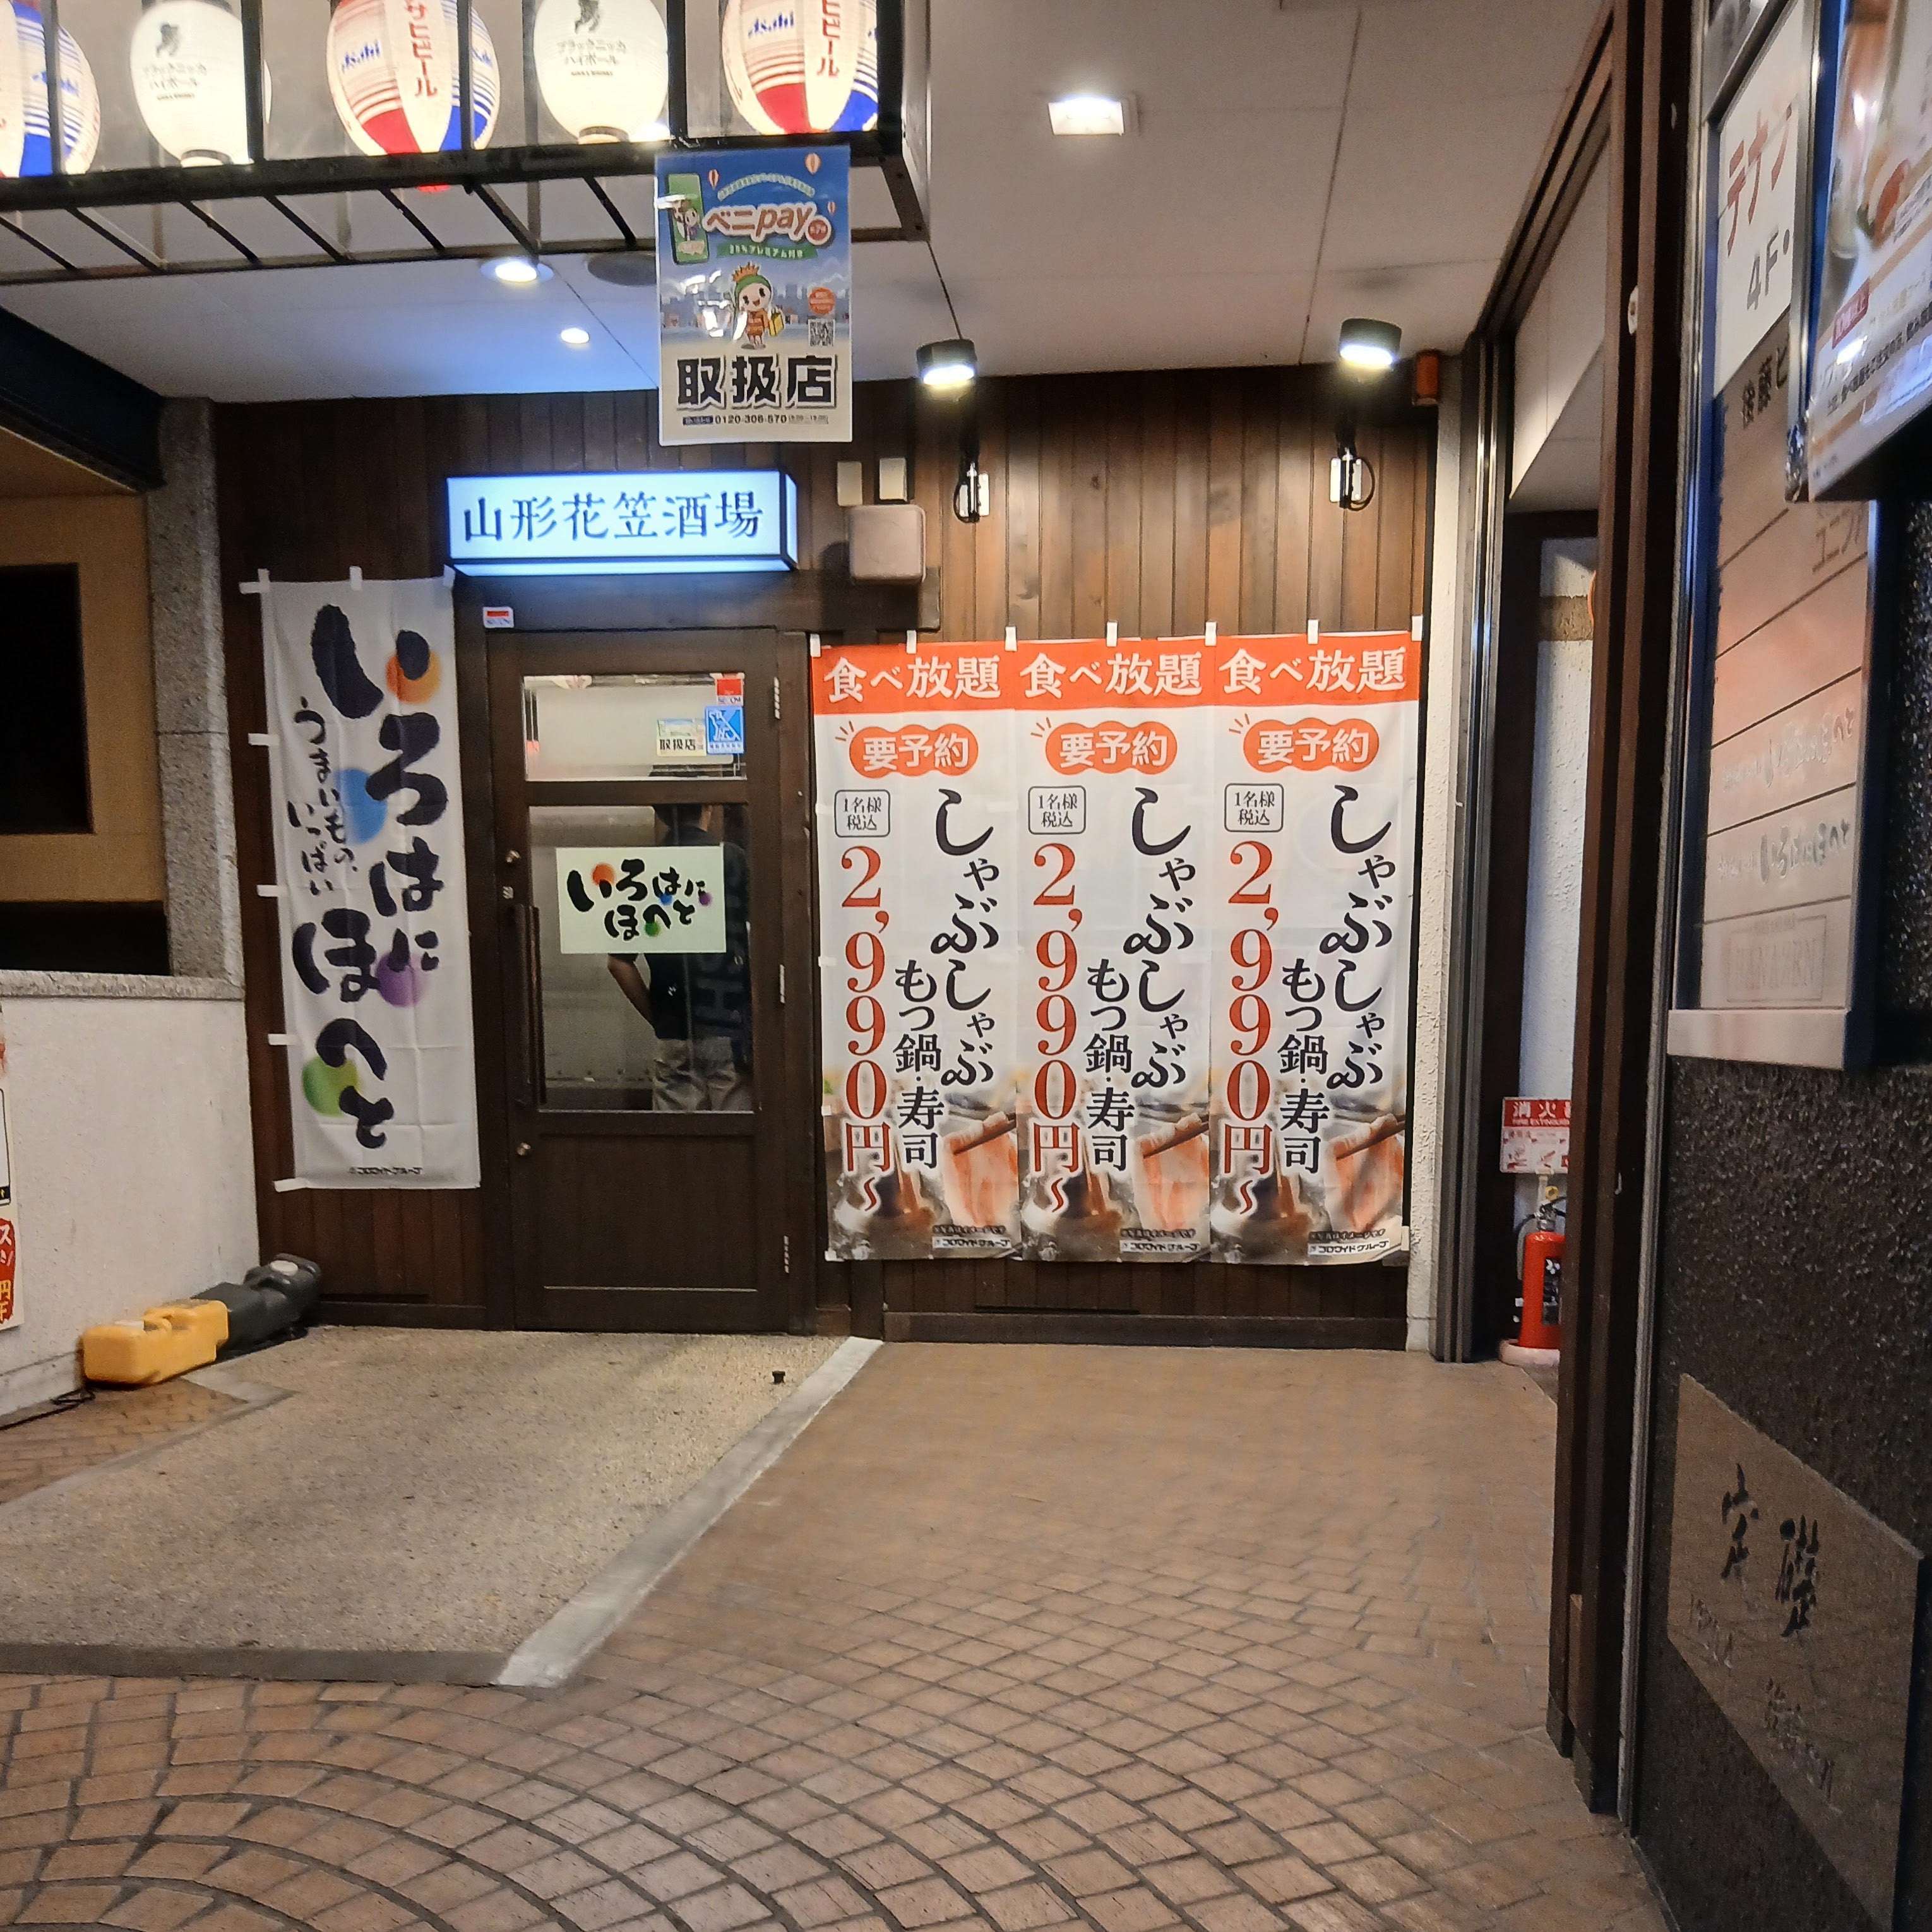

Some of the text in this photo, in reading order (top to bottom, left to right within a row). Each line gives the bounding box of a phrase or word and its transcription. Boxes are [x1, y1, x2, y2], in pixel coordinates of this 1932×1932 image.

[677, 355, 835, 407] 取扱店
[463, 491, 763, 541] 山形花笠酒場
[823, 655, 1001, 703] 食べ放題
[1020, 651, 1202, 699] 食べ放題
[1219, 647, 1406, 695] 食べ放題
[862, 732, 970, 772] 要予約
[1059, 730, 1168, 768] 要予約
[1258, 727, 1369, 765] 要予約
[844, 797, 881, 813] 1名様
[1038, 793, 1077, 809] 1名様
[1041, 811, 1073, 828] 税込
[1234, 790, 1275, 808] 1名様
[1237, 808, 1270, 826] 税込
[847, 814, 878, 831] 税込
[604, 900, 695, 941] ほへと
[931, 788, 999, 1087] しゃぶしゃぶ
[1123, 787, 1195, 1088] しゃぶしゃぶ
[1320, 784, 1396, 1090] しゃぶしゃぶ
[893, 959, 945, 1168] もつ鍋・寿司
[1083, 958, 1135, 1172] もつ鍋・寿司
[1277, 958, 1330, 1174] もつ鍋・寿司
[1318, 1241, 1388, 1253] コロワイドグループ
